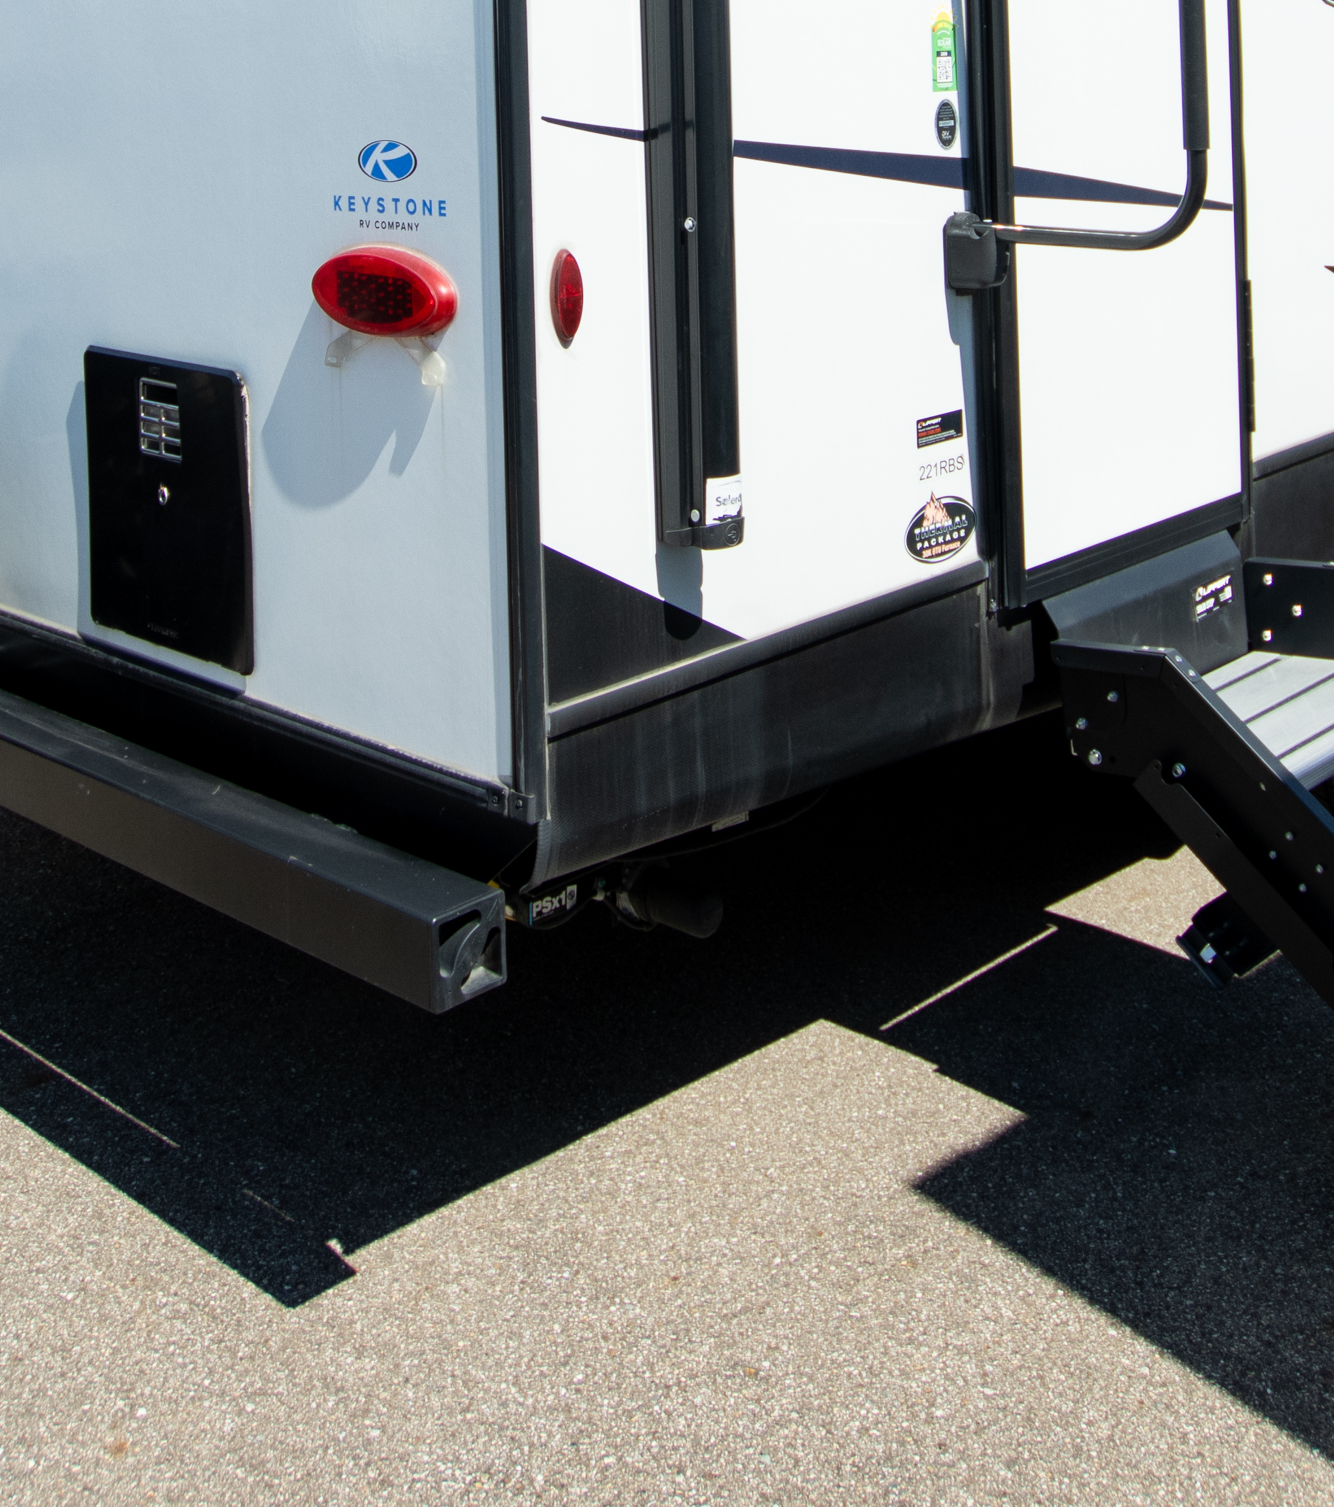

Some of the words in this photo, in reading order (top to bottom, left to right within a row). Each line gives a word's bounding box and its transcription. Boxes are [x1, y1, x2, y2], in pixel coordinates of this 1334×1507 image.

[333, 195, 447, 217] KEYSTONE
[359, 219, 371, 229] RV
[374, 220, 420, 231] COMPANY
[919, 455, 964, 480] 221RBS
[914, 514, 968, 541] THERMAL
[917, 529, 966, 550] PACKAGE
[532, 890, 566, 919] PSx1
